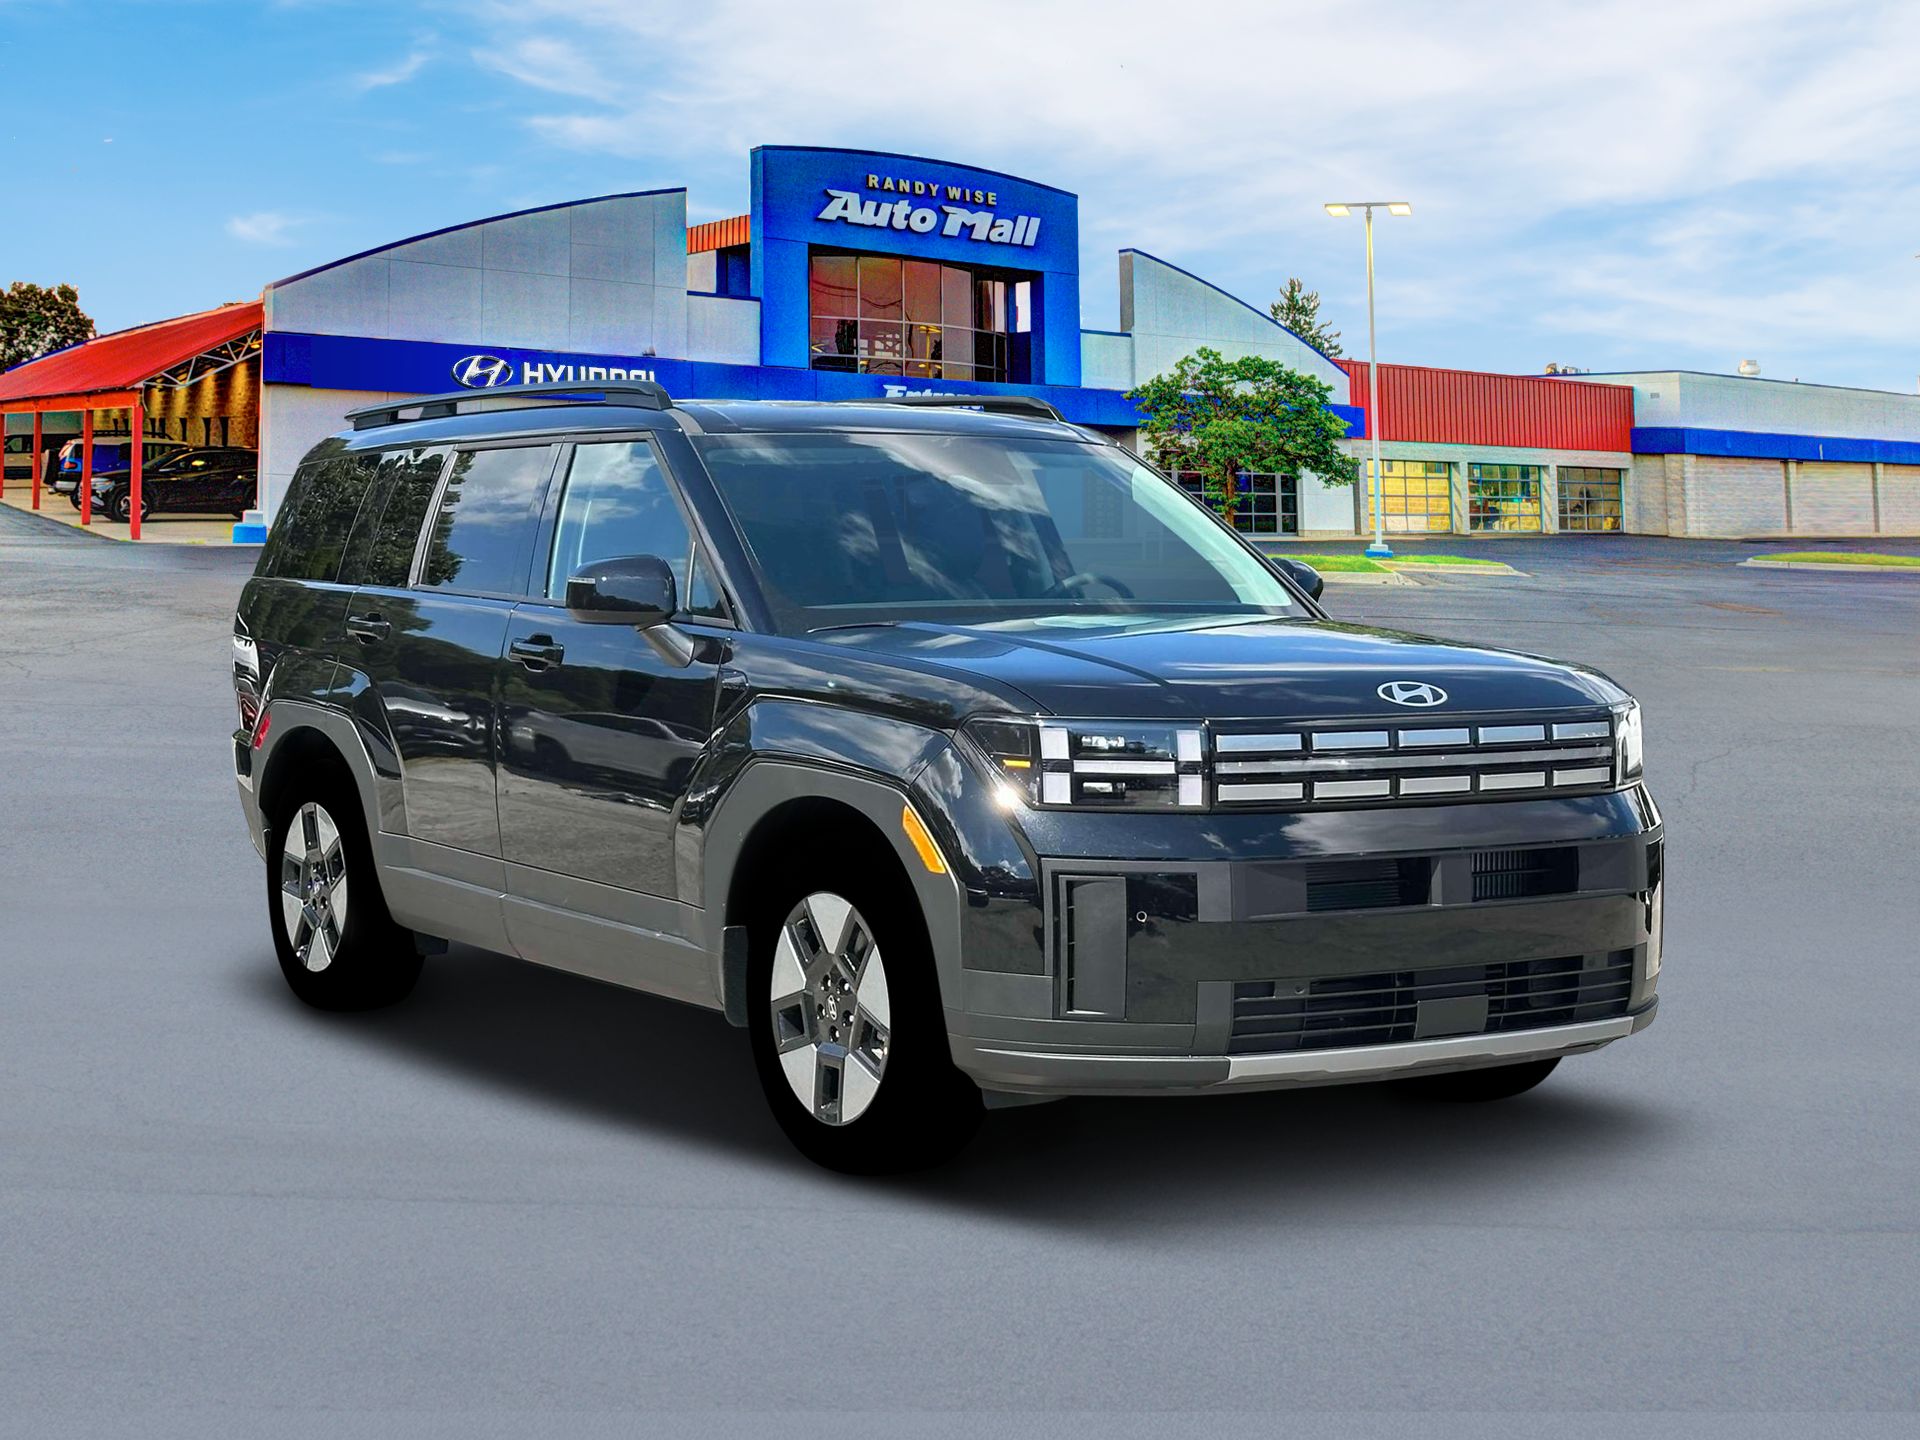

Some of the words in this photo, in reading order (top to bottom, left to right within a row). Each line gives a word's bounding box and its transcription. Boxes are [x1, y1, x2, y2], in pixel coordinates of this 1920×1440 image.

[867, 174, 939, 197] RANDY
[947, 186, 997, 205] WISE
[818, 188, 937, 233] Auto
[942, 205, 1041, 246] Mall
